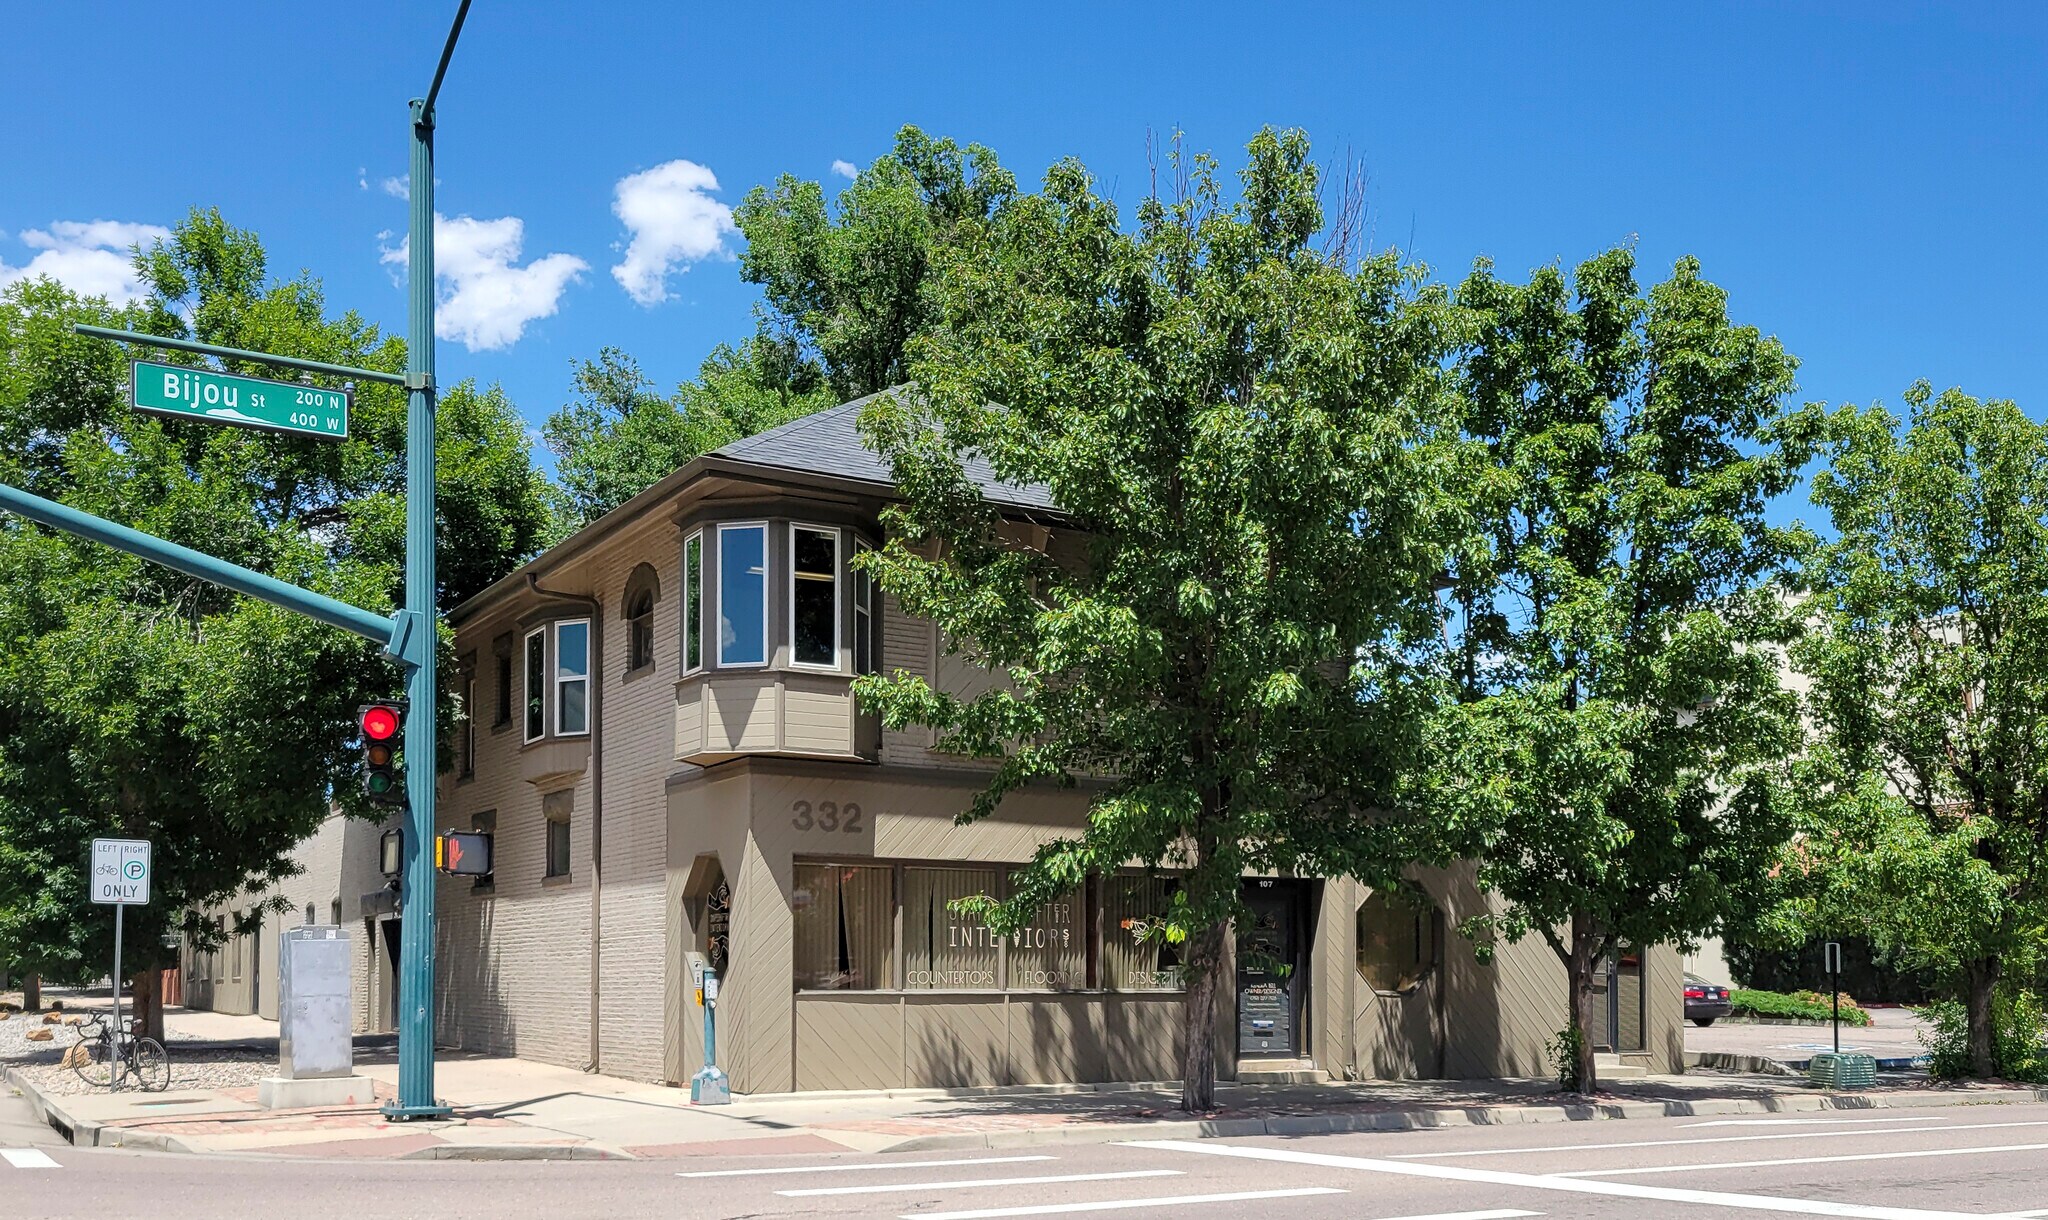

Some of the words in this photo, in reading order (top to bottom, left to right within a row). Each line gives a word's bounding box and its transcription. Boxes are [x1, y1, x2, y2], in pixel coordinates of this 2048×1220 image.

[163, 372, 238, 409] Bijou
[251, 393, 265, 408] St
[295, 391, 323, 407] 200
[329, 396, 339, 409] N
[289, 412, 318, 427] 400
[326, 417, 339, 430] W
[791, 800, 863, 833] 332
[97, 844, 117, 853] LEFT
[124, 845, 148, 854] RIGHT
[131, 864, 142, 876] P
[103, 884, 138, 898] ONLY
[1259, 880, 1273, 888] 107
[907, 970, 994, 985] COUNTERTOPS
[1128, 971, 1167, 985] DESIG
